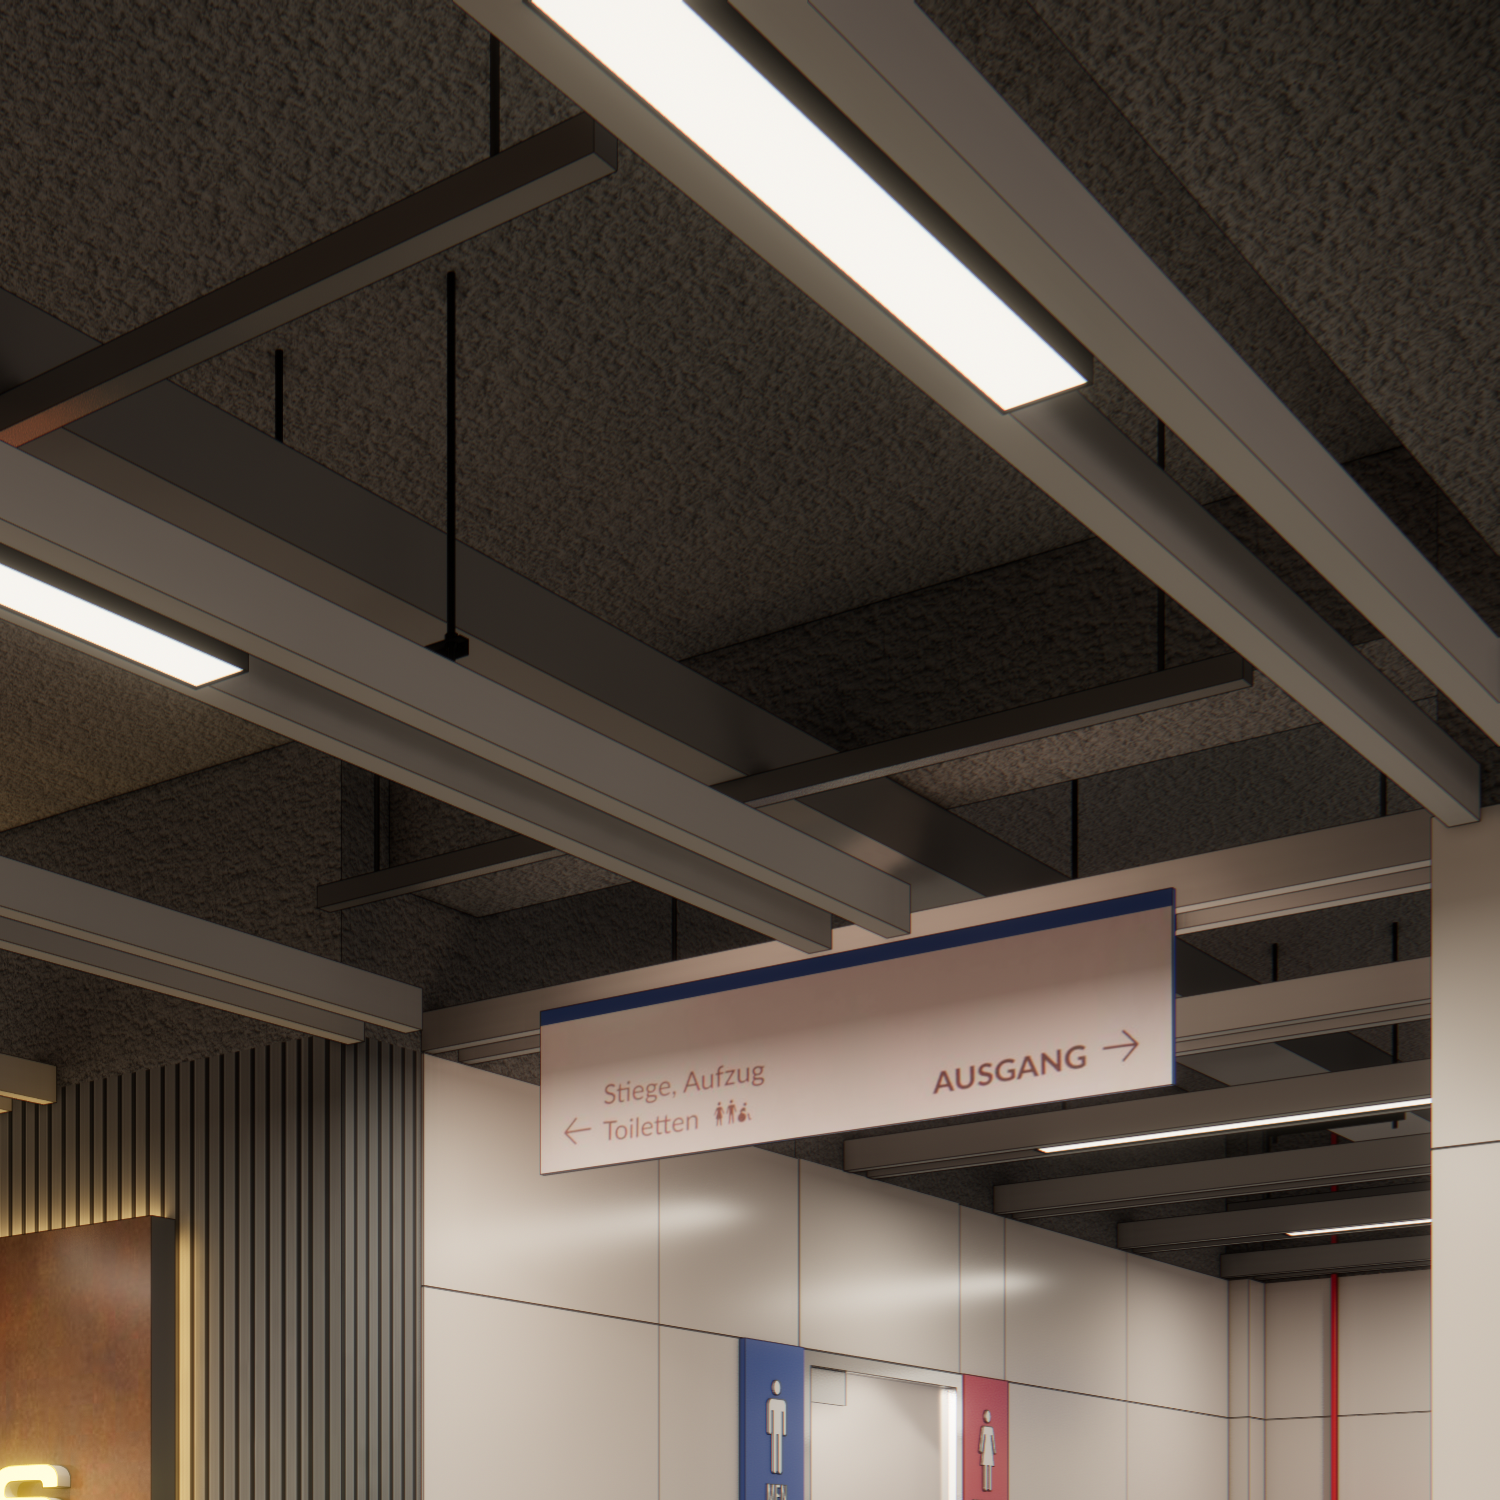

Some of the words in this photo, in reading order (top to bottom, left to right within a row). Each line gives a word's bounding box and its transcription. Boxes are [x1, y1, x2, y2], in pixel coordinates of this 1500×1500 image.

[603, 1080, 677, 1105] Stiege,
[682, 1064, 766, 1093] Aufzug
[932, 1044, 1088, 1095] AUSGANG
[603, 1113, 699, 1141] Toiletten
